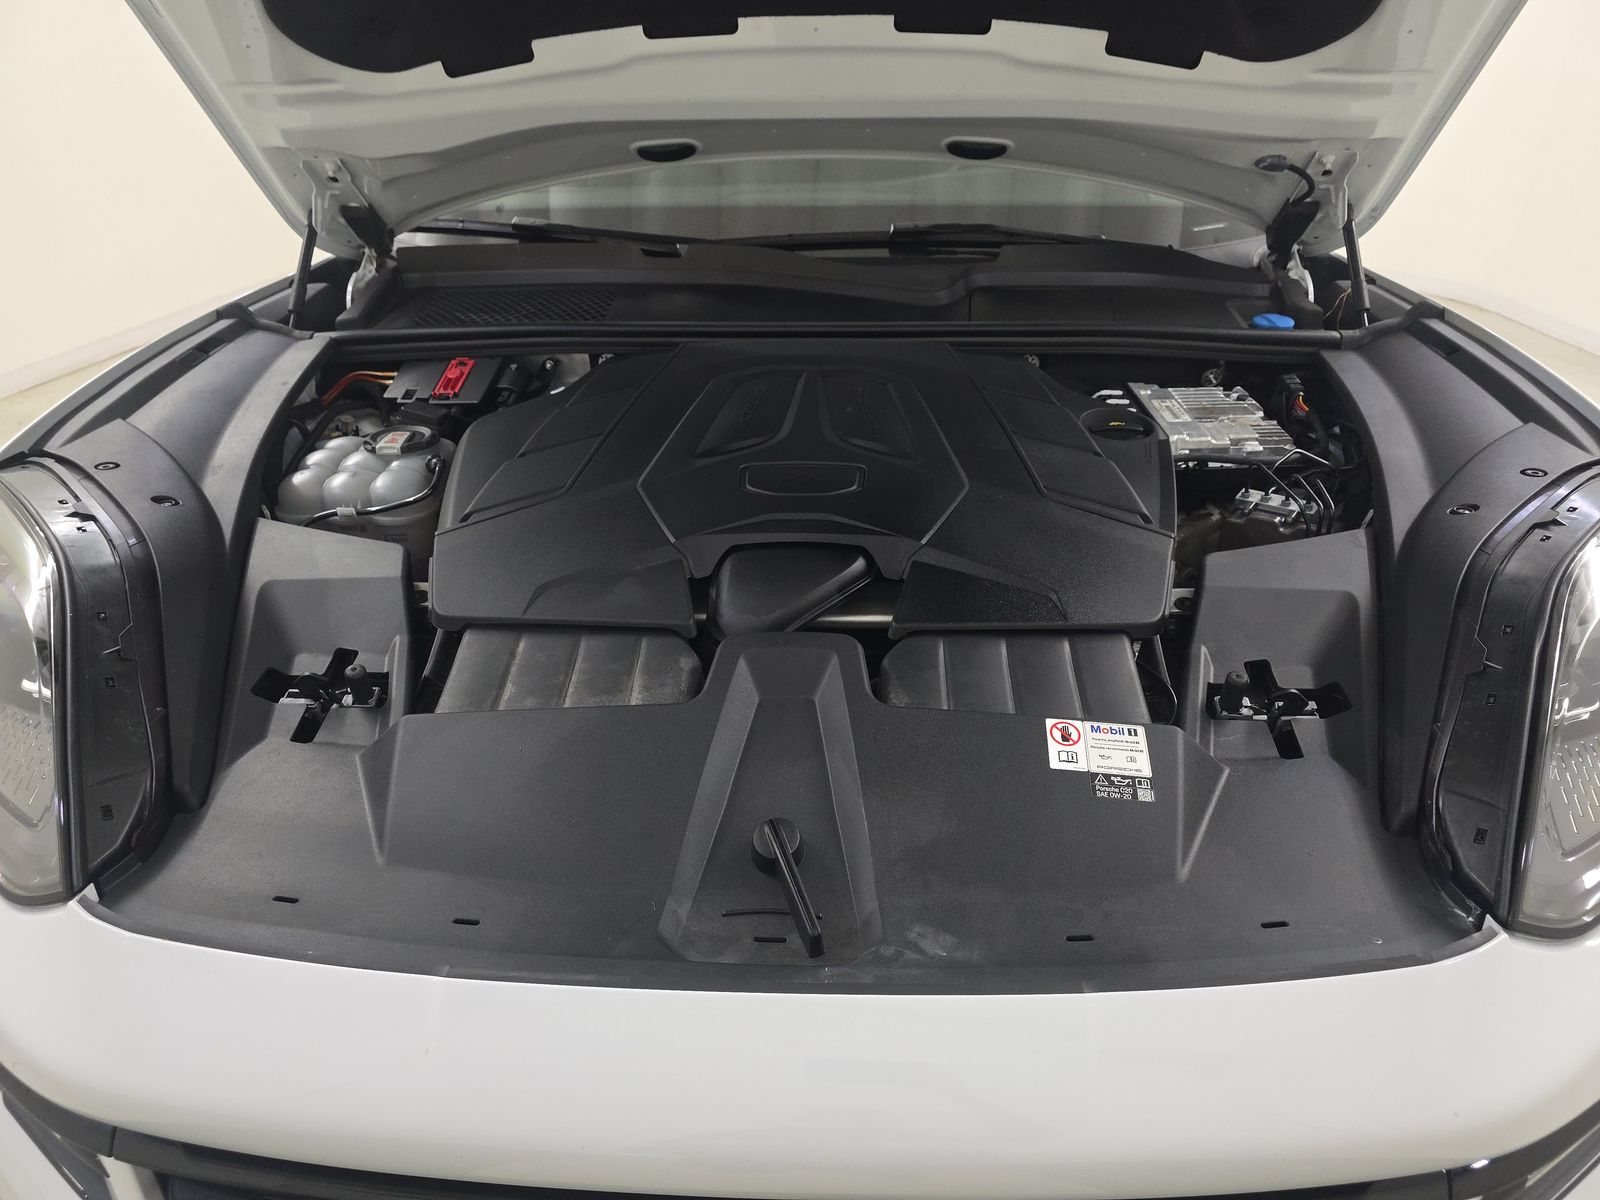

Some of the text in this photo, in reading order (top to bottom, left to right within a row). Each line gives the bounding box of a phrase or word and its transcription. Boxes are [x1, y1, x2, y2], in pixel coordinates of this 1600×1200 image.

[1091, 725, 1138, 737] Mobil 1
[1097, 765, 1143, 773] PORSCHE
[1096, 785, 1119, 793] Porsche
[1109, 792, 1132, 800] 0W-20
